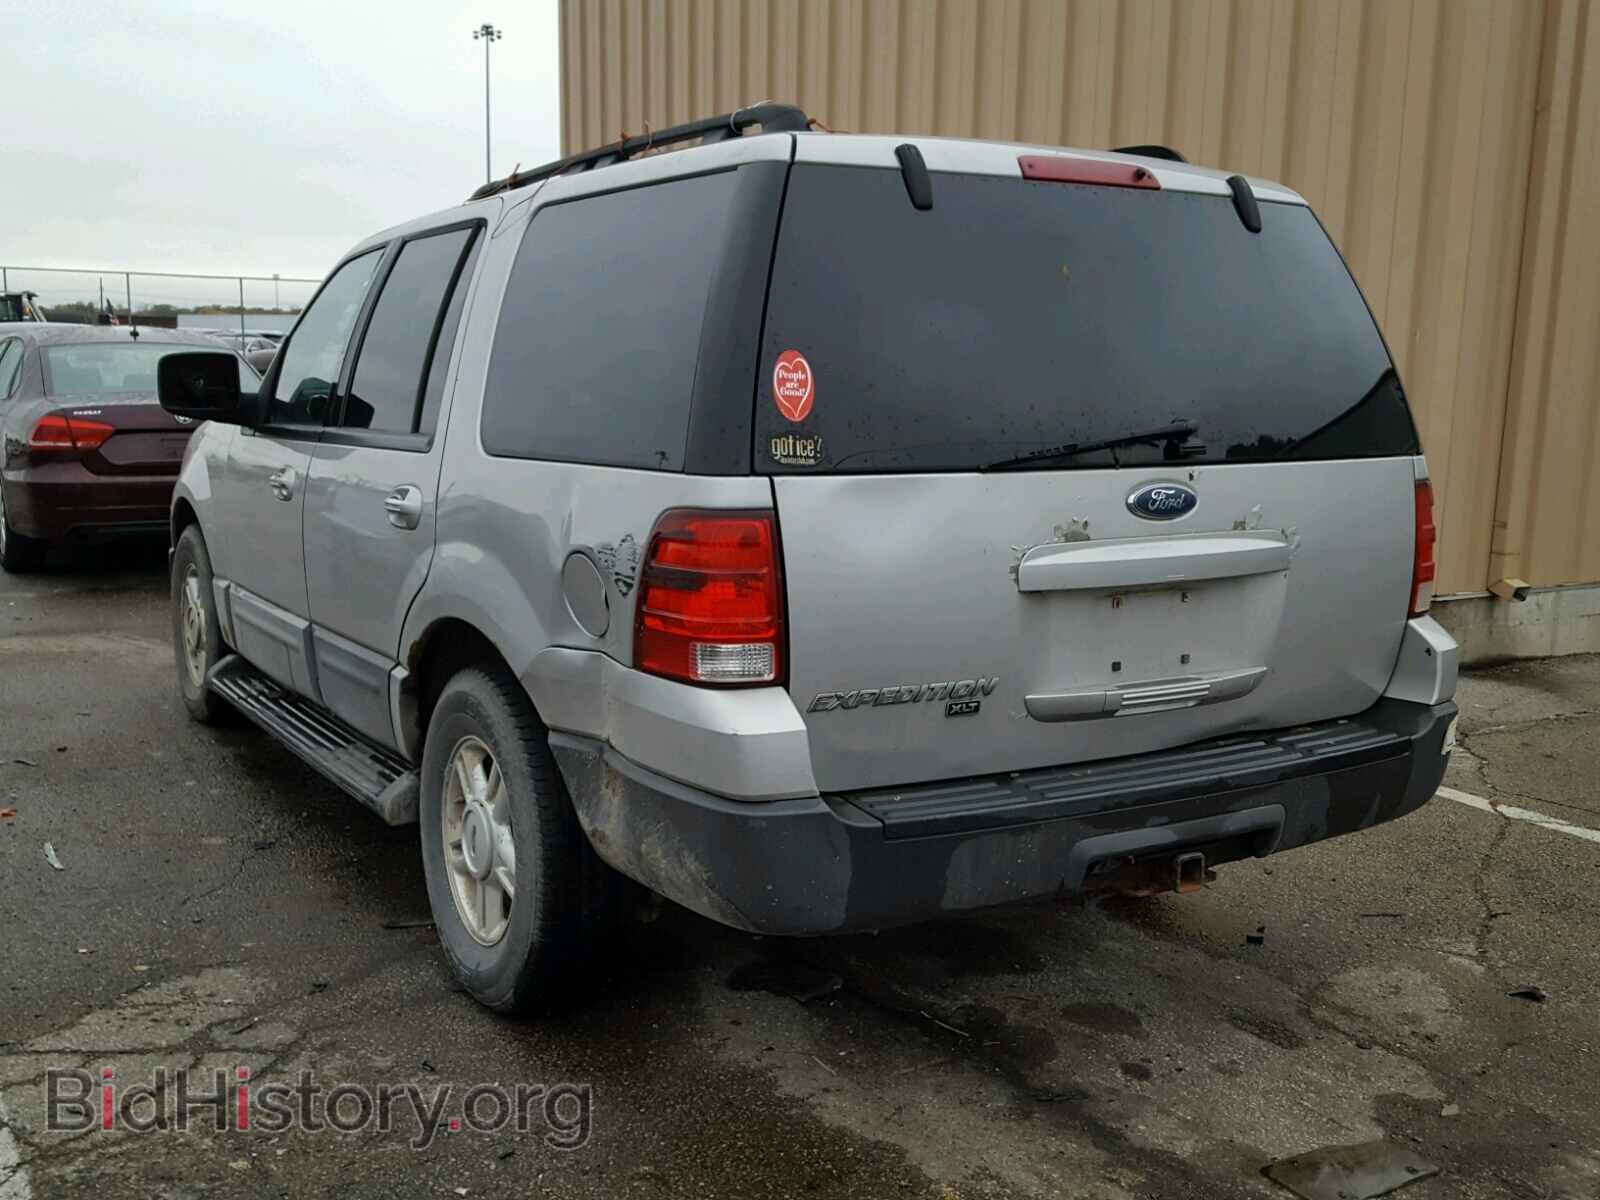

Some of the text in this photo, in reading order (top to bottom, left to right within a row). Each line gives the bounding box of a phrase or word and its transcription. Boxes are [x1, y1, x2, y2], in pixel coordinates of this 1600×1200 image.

[778, 369, 807, 383] People
[785, 381, 800, 390] are
[771, 434, 794, 460] got
[1148, 488, 1186, 512] Ford
[806, 675, 1000, 714] EXPEDITION
[949, 702, 979, 715] XLT
